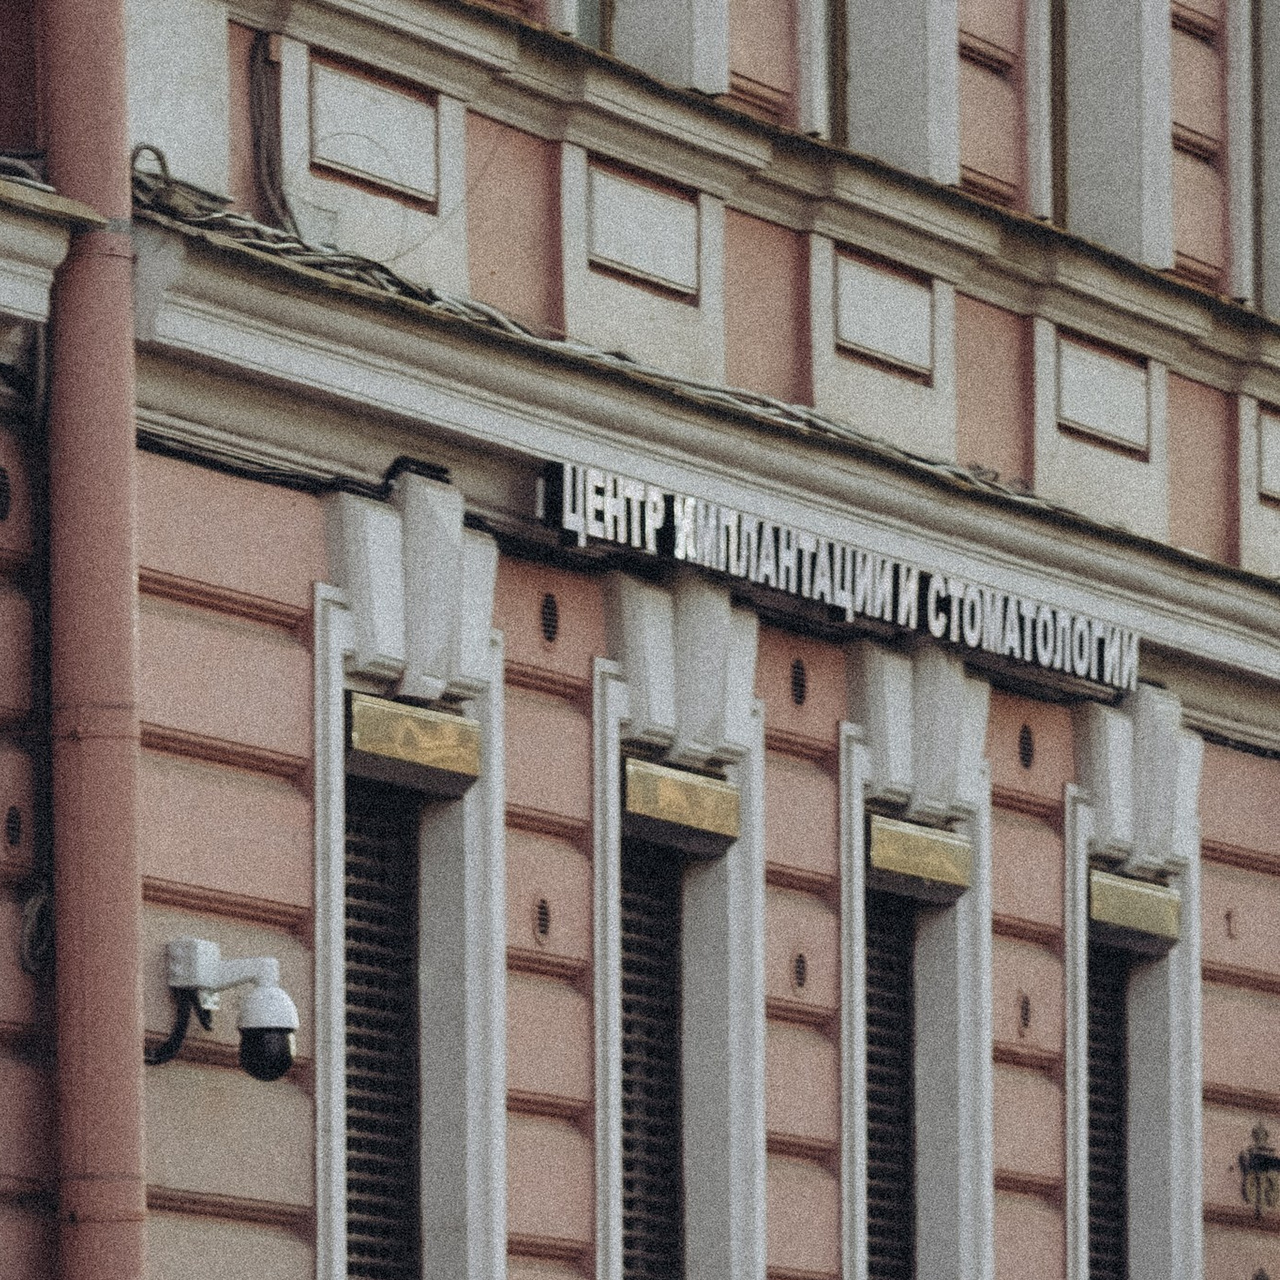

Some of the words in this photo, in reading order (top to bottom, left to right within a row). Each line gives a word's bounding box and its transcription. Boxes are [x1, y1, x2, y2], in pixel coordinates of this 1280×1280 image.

[563, 463, 665, 554] ЦЕНТР
[673, 494, 894, 623] ИМПЛАНТАЦИИ
[897, 560, 919, 630] И
[927, 573, 1139, 692] СТОМАТОЛОГИИ
